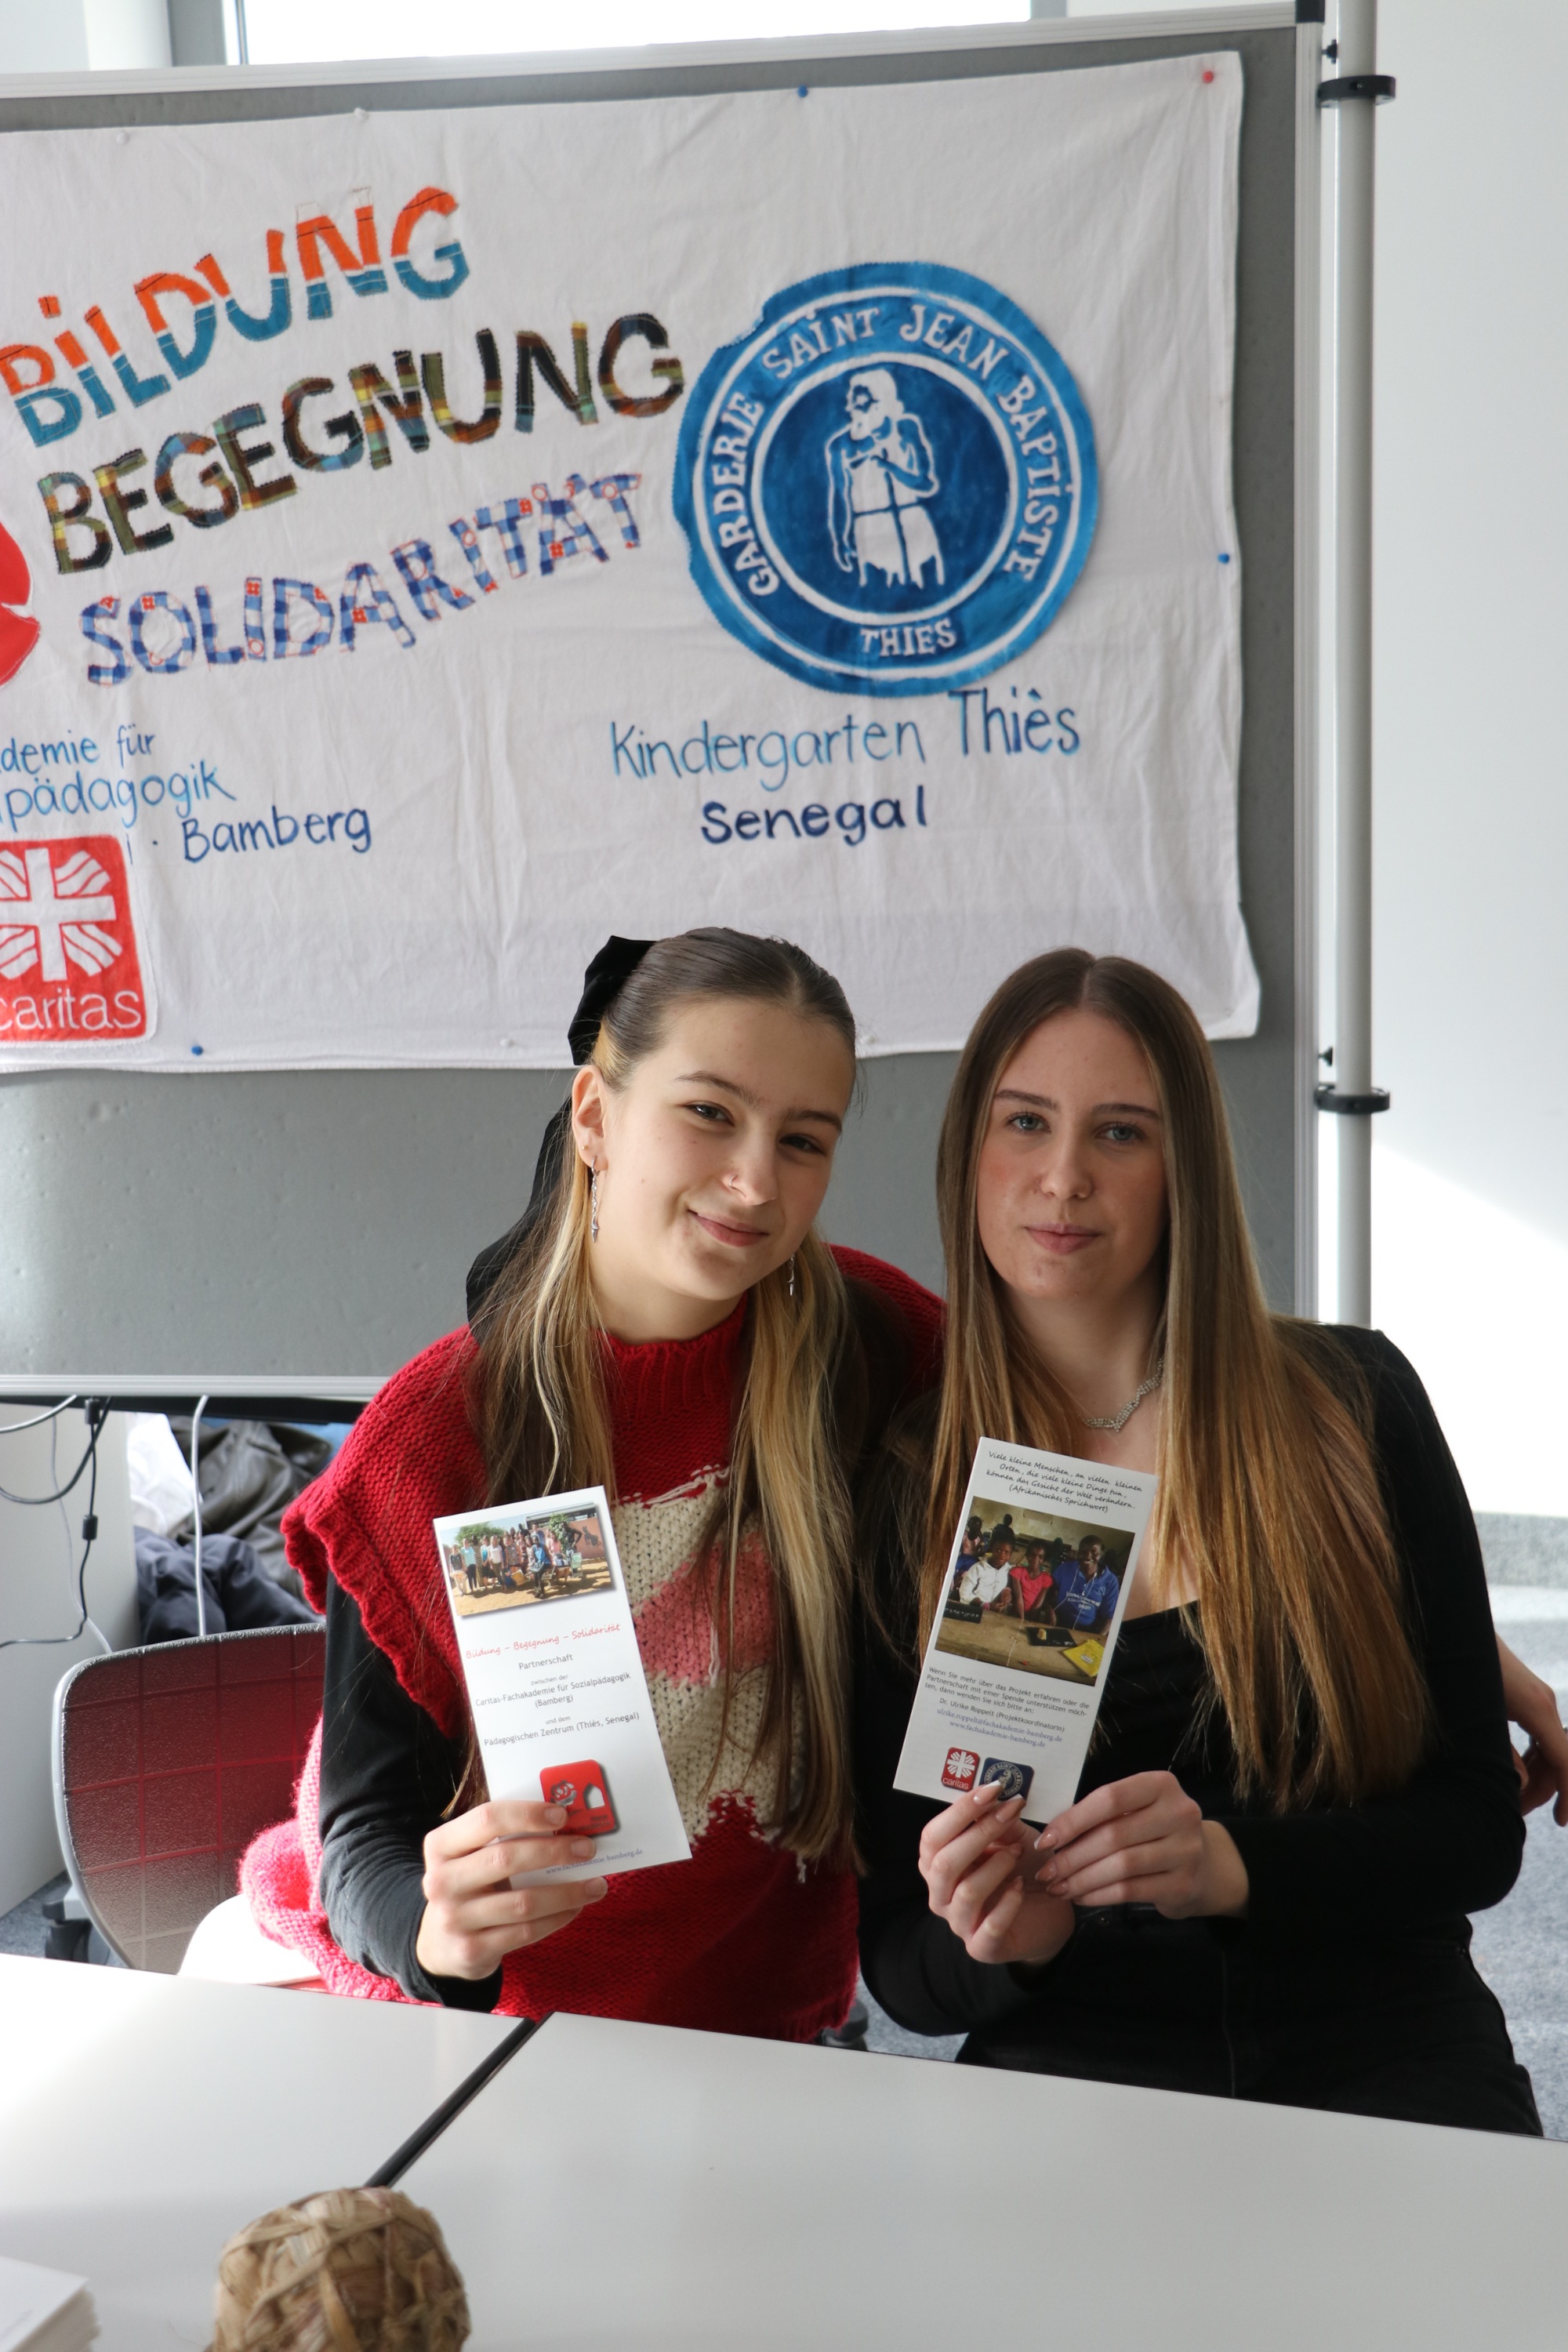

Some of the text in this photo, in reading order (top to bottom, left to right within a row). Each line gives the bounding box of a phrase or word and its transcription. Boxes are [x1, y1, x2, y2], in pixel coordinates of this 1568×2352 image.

[38, 314, 684, 574] BEGEGNUNG
[712, 391, 779, 597] GARDERIE
[899, 304, 1010, 381] JEAN
[79, 473, 641, 688] SOLIDARITÄT
[861, 618, 956, 658] THIES
[0, 723, 155, 775] demie für
[611, 686, 1080, 792] Kindergarten Thiès
[0, 759, 237, 833] pädagogik
[701, 785, 927, 846] Senegal
[182, 806, 371, 862] Bamberg
[985, 1468, 1014, 1481] können
[1016, 1476, 1029, 1486] das
[1031, 1480, 1060, 1492] Gesicht
[1076, 1490, 1093, 1500] Welt
[1094, 1496, 1136, 1509] verändern.
[989, 1450, 1007, 1461] Viele
[1008, 1456, 1032, 1467] kleine
[1087, 1475, 1110, 1485] vielen
[1115, 1480, 1142, 1492] kleinen
[1026, 1469, 1039, 1478] die
[1060, 1477, 1083, 1488] kleine
[1086, 1483, 1108, 1494] Dinge
[1009, 1483, 1109, 1513] (Afrikanisches Sprichwort)
[466, 1646, 501, 1659] Bildung
[513, 1635, 560, 1650] Begegnung
[572, 1623, 620, 1639] Solidarität
[518, 1653, 573, 1670] Partnerschaft
[475, 1686, 556, 1706] Caritas-Fachakademie
[570, 1671, 631, 1690] Sozialpädagogik
[530, 1676, 557, 1686] zwischen
[924, 1682, 937, 1691] ten,
[938, 1686, 955, 1695] dann
[956, 1691, 981, 1701] wenden
[1007, 1702, 1023, 1711] bitte
[926, 1674, 969, 1690] Partnerschaft
[1001, 1693, 1025, 1703] Spende
[929, 1666, 946, 1676] Wenn
[960, 1675, 977, 1684] mehr
[1008, 1686, 1031, 1697] Projekt
[1033, 1693, 1061, 1703] erfahren
[535, 1693, 573, 1708] (Bamberg)
[949, 1700, 969, 1711] Ulrike
[970, 1705, 994, 1717] Roppelt
[996, 1711, 1065, 1733] (Projektkoordinatorin)
[484, 1711, 640, 1746] Pädagogischen Zentrum (Thiès, Senegal)
[942, 1777, 969, 1789] caritas
